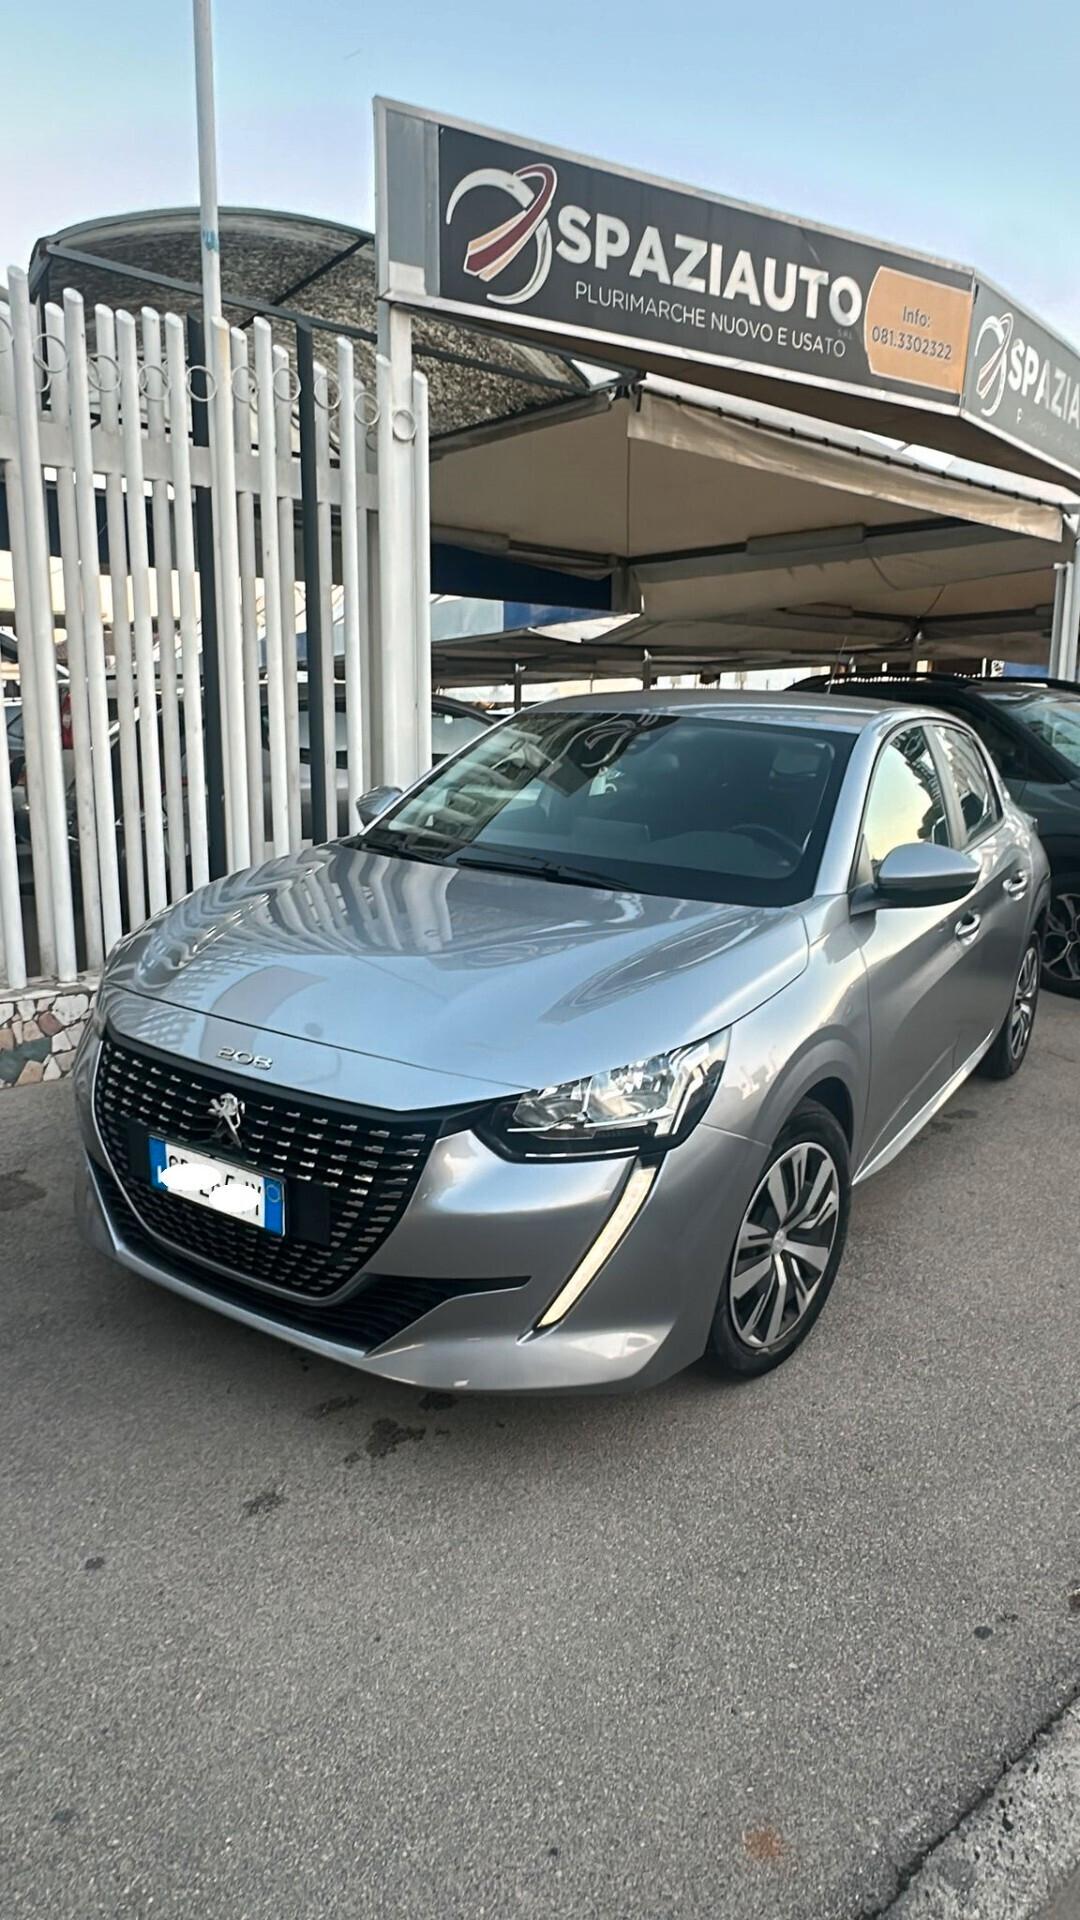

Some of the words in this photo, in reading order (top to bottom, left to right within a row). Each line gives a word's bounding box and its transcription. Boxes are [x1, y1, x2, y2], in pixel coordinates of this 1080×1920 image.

[556, 205, 862, 326] SPAZIAUTO
[575, 281, 706, 328] PLURIMARCHE
[710, 311, 773, 342] NUOVO
[777, 327, 788, 346] E
[791, 330, 846, 358] USATO
[902, 305, 931, 328] Info:
[871, 325, 953, 361] 081.3302322
[216, 1046, 273, 1071] 208
